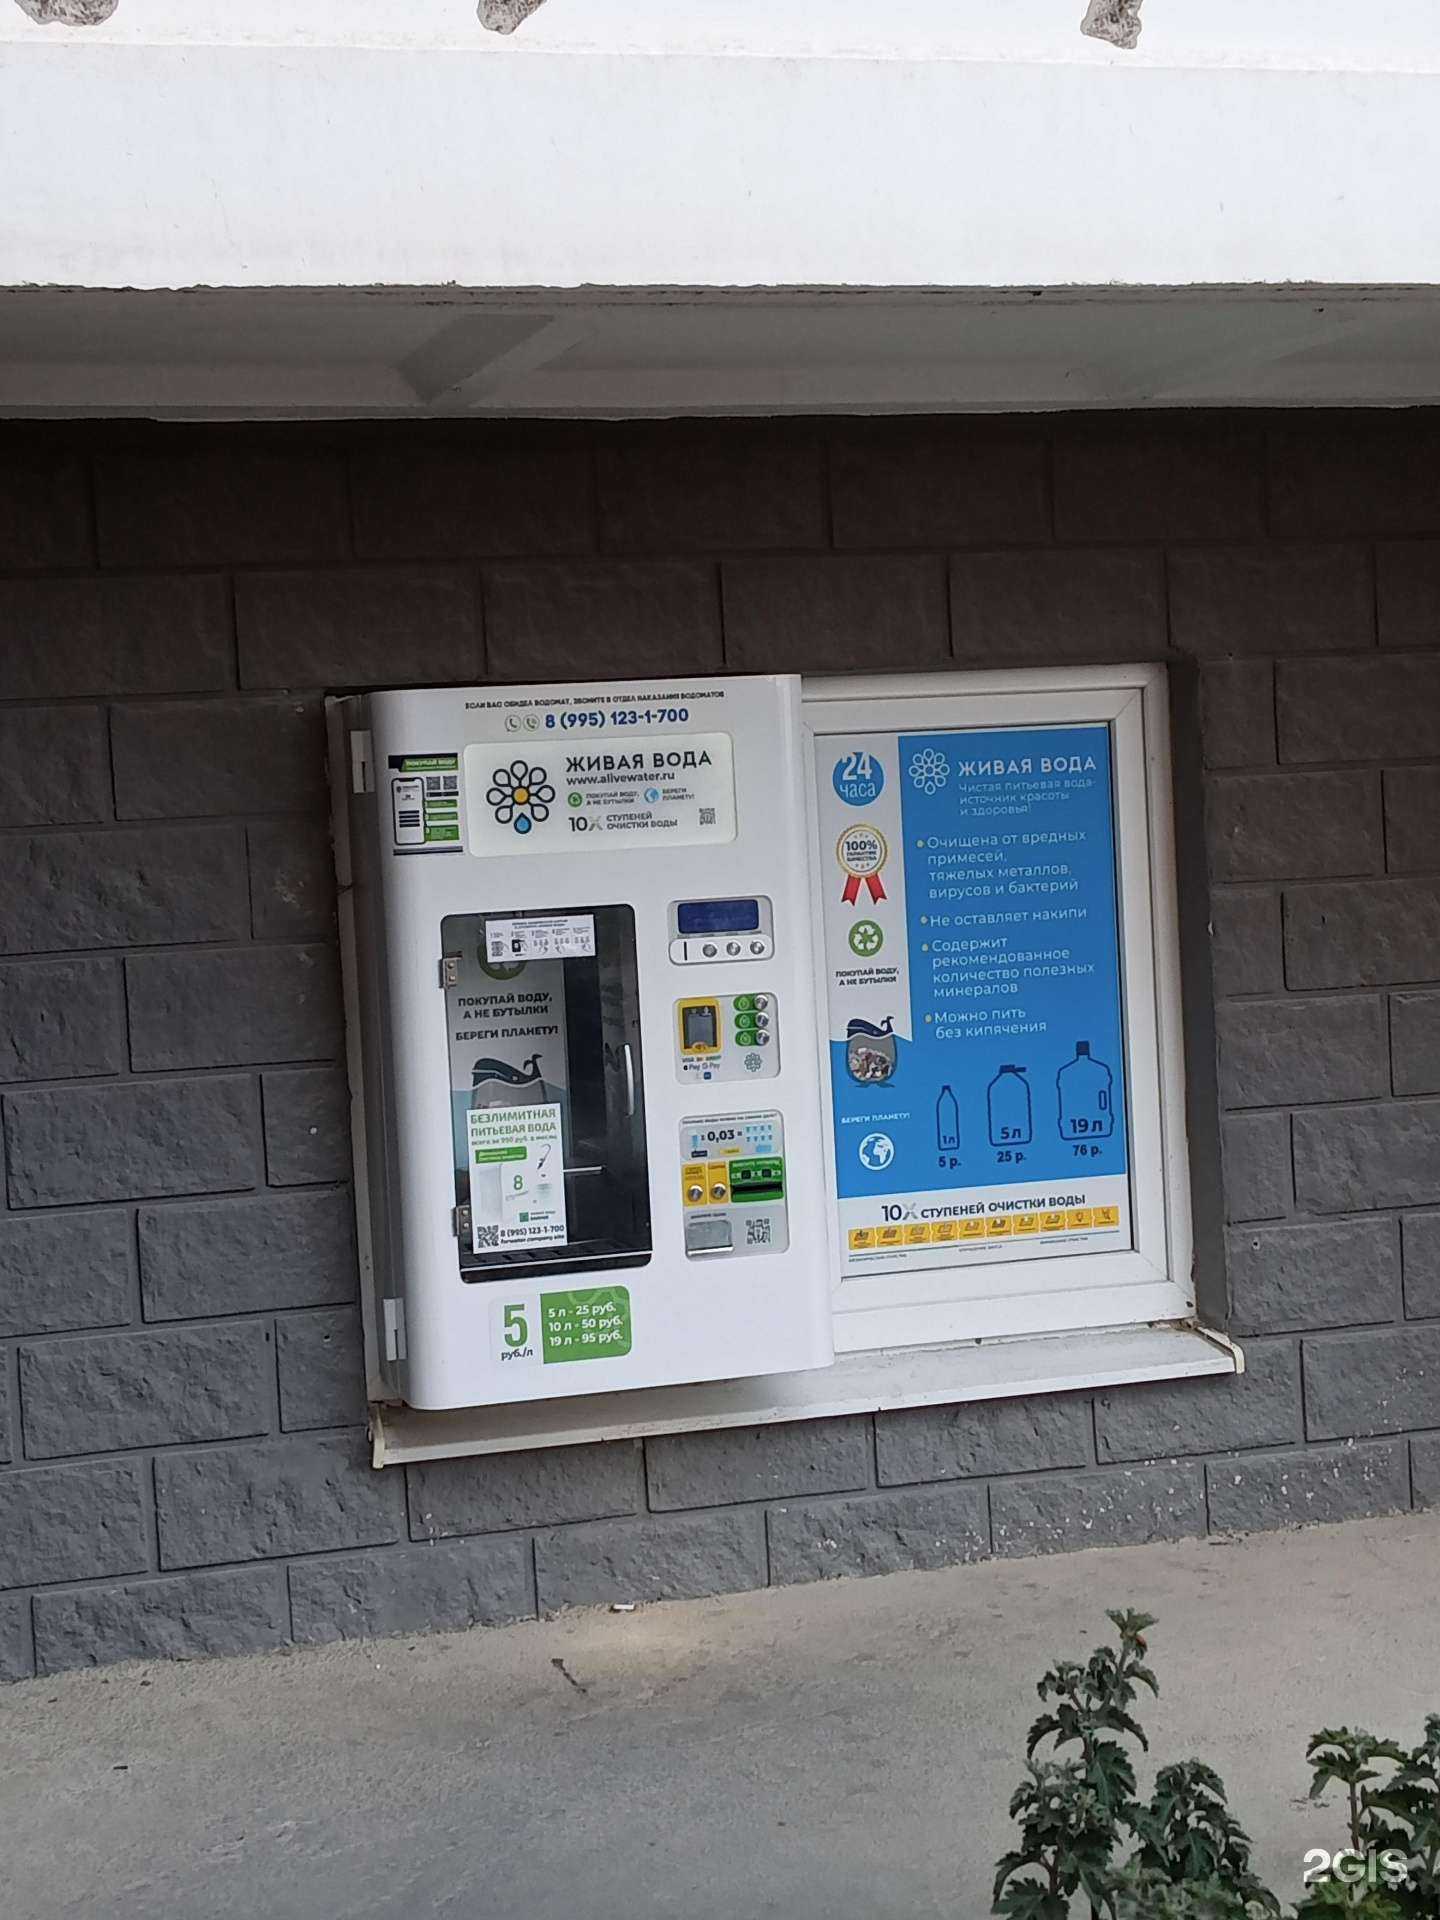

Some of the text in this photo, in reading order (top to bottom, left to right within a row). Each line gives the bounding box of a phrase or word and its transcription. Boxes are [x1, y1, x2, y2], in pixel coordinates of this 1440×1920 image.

[546, 708, 689, 730] 8 (995) 123-1-700
[566, 750, 712, 772] ЖИВАЯ ВОДА
[841, 752, 872, 780] 24
[958, 756, 1096, 776] ЖИВАЯ ВОДА
[566, 772, 675, 786] www.alivewater.ru
[959, 782, 1001, 793] Чистая
[1005, 780, 1061, 791] питьевая
[840, 782, 876, 798] часа
[960, 792, 1070, 805] источник красоты
[606, 811, 652, 822] СТУПЕНЕЙ
[960, 808, 968, 816] и
[607, 820, 678, 830] ОЧИСТКИ ВОДЫ
[846, 840, 878, 851] 100%
[926, 830, 1086, 850] Очищена от вредных
[929, 868, 994, 882] тяжелых
[929, 878, 1078, 900] вирусов и бактерий
[930, 908, 1088, 928] Не оставляет накипи
[932, 936, 1008, 954] Содержит
[932, 948, 1070, 968] рекомендованное
[836, 966, 900, 978] ПОКУПАЙ ВОДУ,
[933, 962, 1096, 984] количество полезных
[838, 976, 897, 986] А НЕ БУТЫЛКИ
[934, 982, 1018, 1000] минералов
[458, 992, 553, 1007] ПОКУПАЙ ВОДУ,
[463, 1006, 548, 1020] А НЕ БУТЫЛКИ
[934, 1008, 1026, 1024] Можно пить
[456, 1026, 559, 1041] БЕРЕГИ ПЛАНЕТУ!
[936, 1021, 1047, 1040] без кипячения
[470, 1108, 556, 1124] БЕЗЛИМИТНАЯ
[841, 1112, 910, 1124] БЕРЕГИ ПЛАНЕТУ!
[470, 1122, 557, 1138] ПИТЬЕВАЯ ВОДА
[1070, 1118, 1103, 1134] 19 л
[707, 1130, 735, 1142] 0,03
[996, 1151, 1028, 1166] 25 р.
[1072, 1144, 1103, 1159] 76 р.
[938, 1156, 962, 1170] 5 р.
[513, 1174, 523, 1190] 8
[920, 1202, 985, 1219] СТУПЕНЕЙ
[988, 1198, 1046, 1214] ОЧИСТКИ
[1049, 1194, 1086, 1208] ВОДЫ
[528, 1225, 564, 1235] 123-1-700
[548, 1308, 556, 1318] 5
[558, 1308, 566, 1317] л
[576, 1304, 590, 1315] 25
[592, 1302, 616, 1316] руб.
[504, 1304, 528, 1347] 5
[548, 1322, 561, 1332] 10
[564, 1322, 572, 1330] л
[582, 1318, 596, 1328] 50
[598, 1315, 623, 1329] руб.
[550, 1336, 562, 1346] 19
[564, 1336, 572, 1344] л
[582, 1333, 596, 1344] 95
[598, 1330, 623, 1344] руб.
[501, 1348, 534, 1361] руб./л
